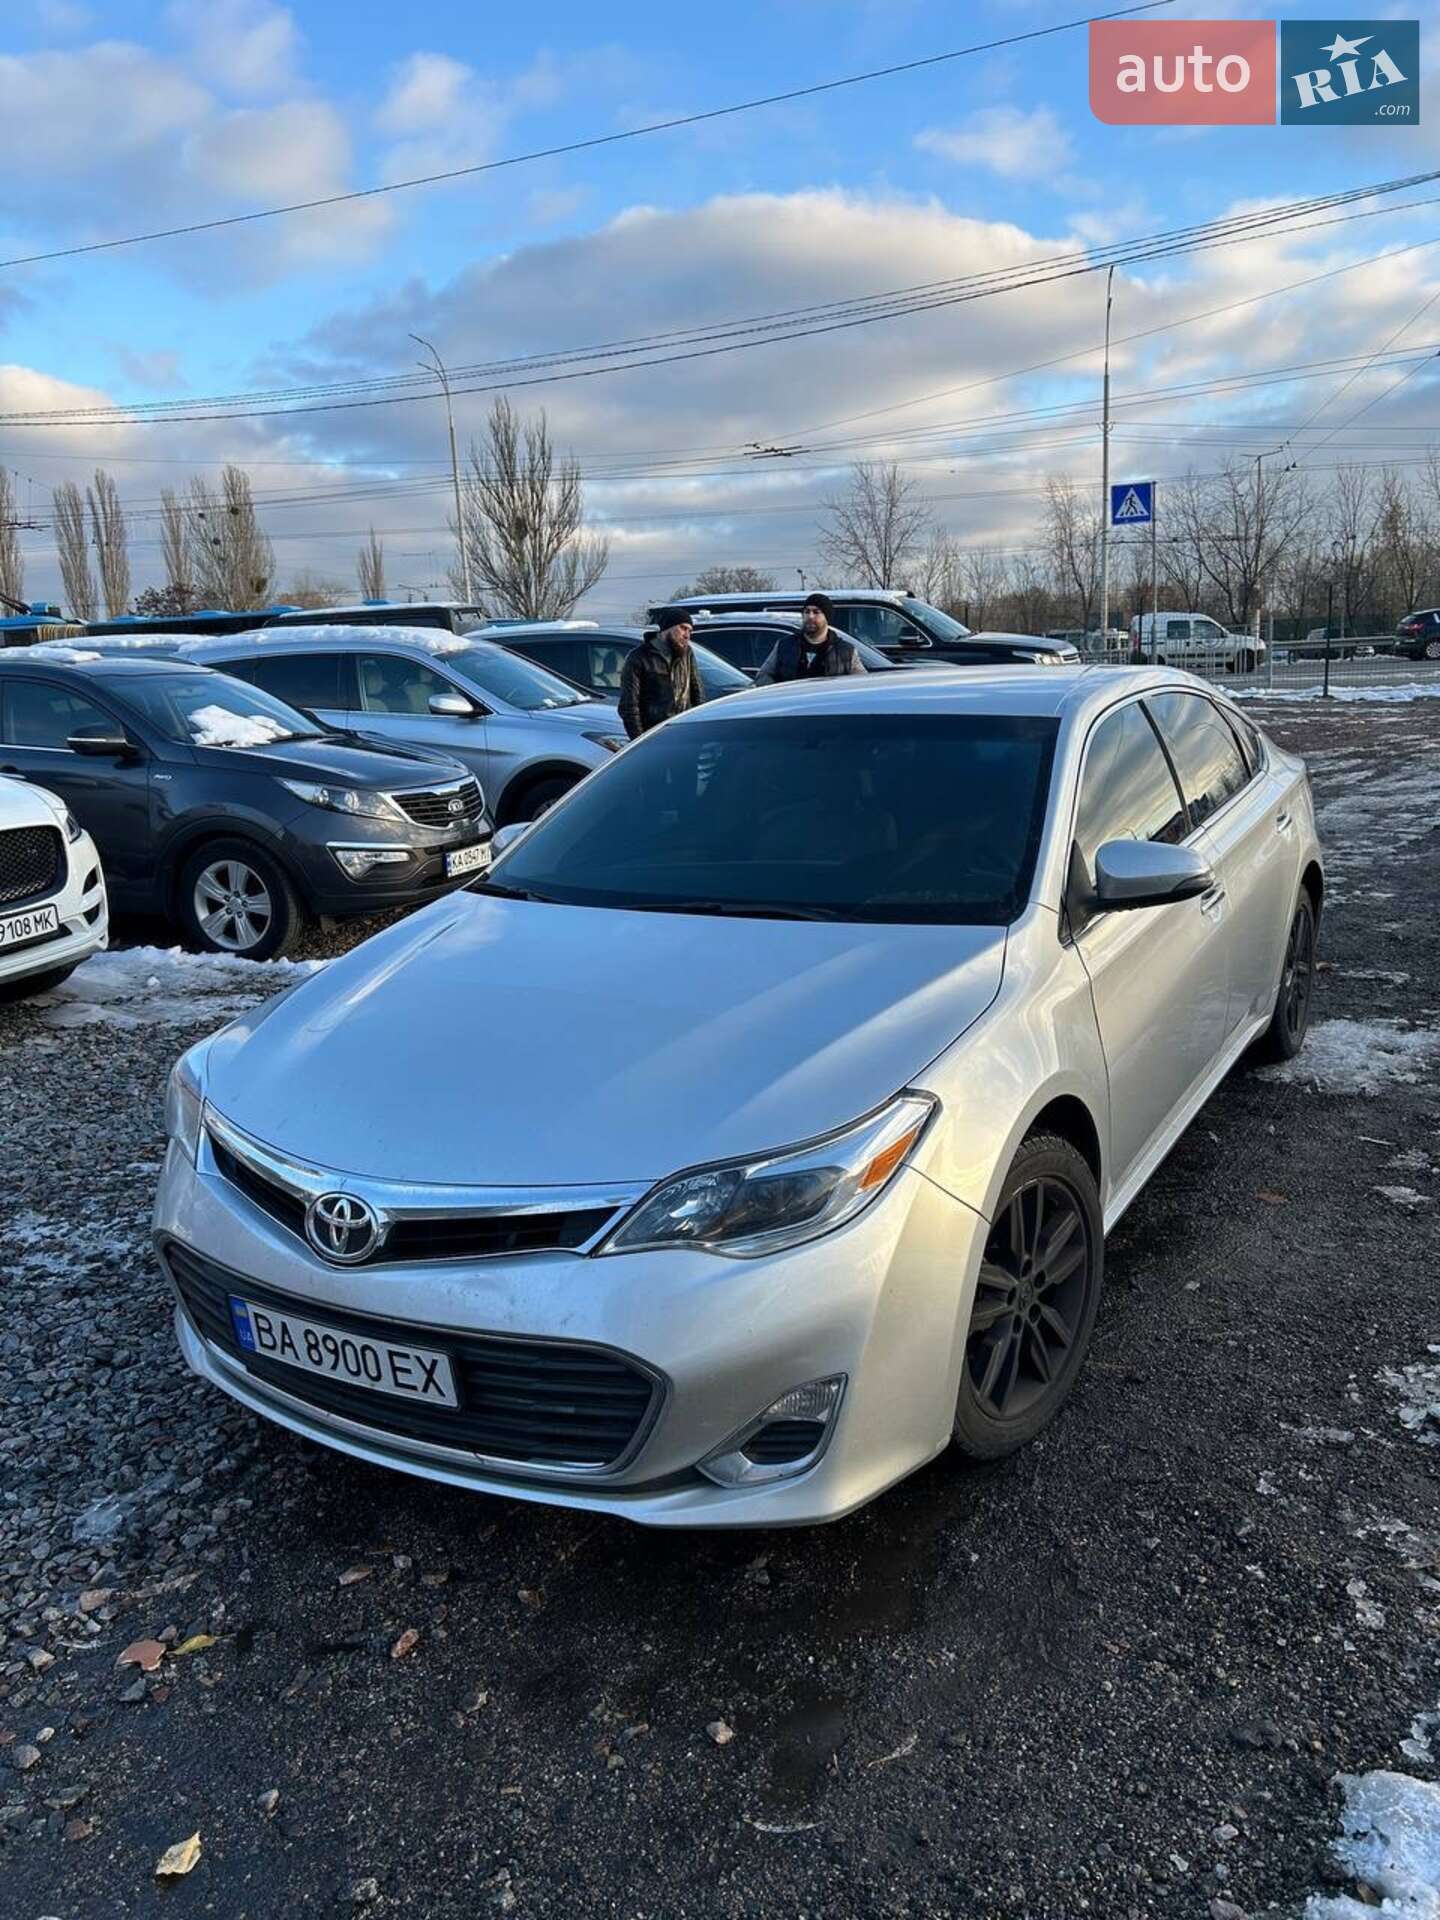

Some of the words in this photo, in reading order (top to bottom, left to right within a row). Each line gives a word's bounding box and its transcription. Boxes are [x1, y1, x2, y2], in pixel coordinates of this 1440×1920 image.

[33, 910, 54, 933] MK
[253, 1311, 300, 1361] BA
[303, 1328, 383, 1382] 8900
[387, 1349, 446, 1398] EX
